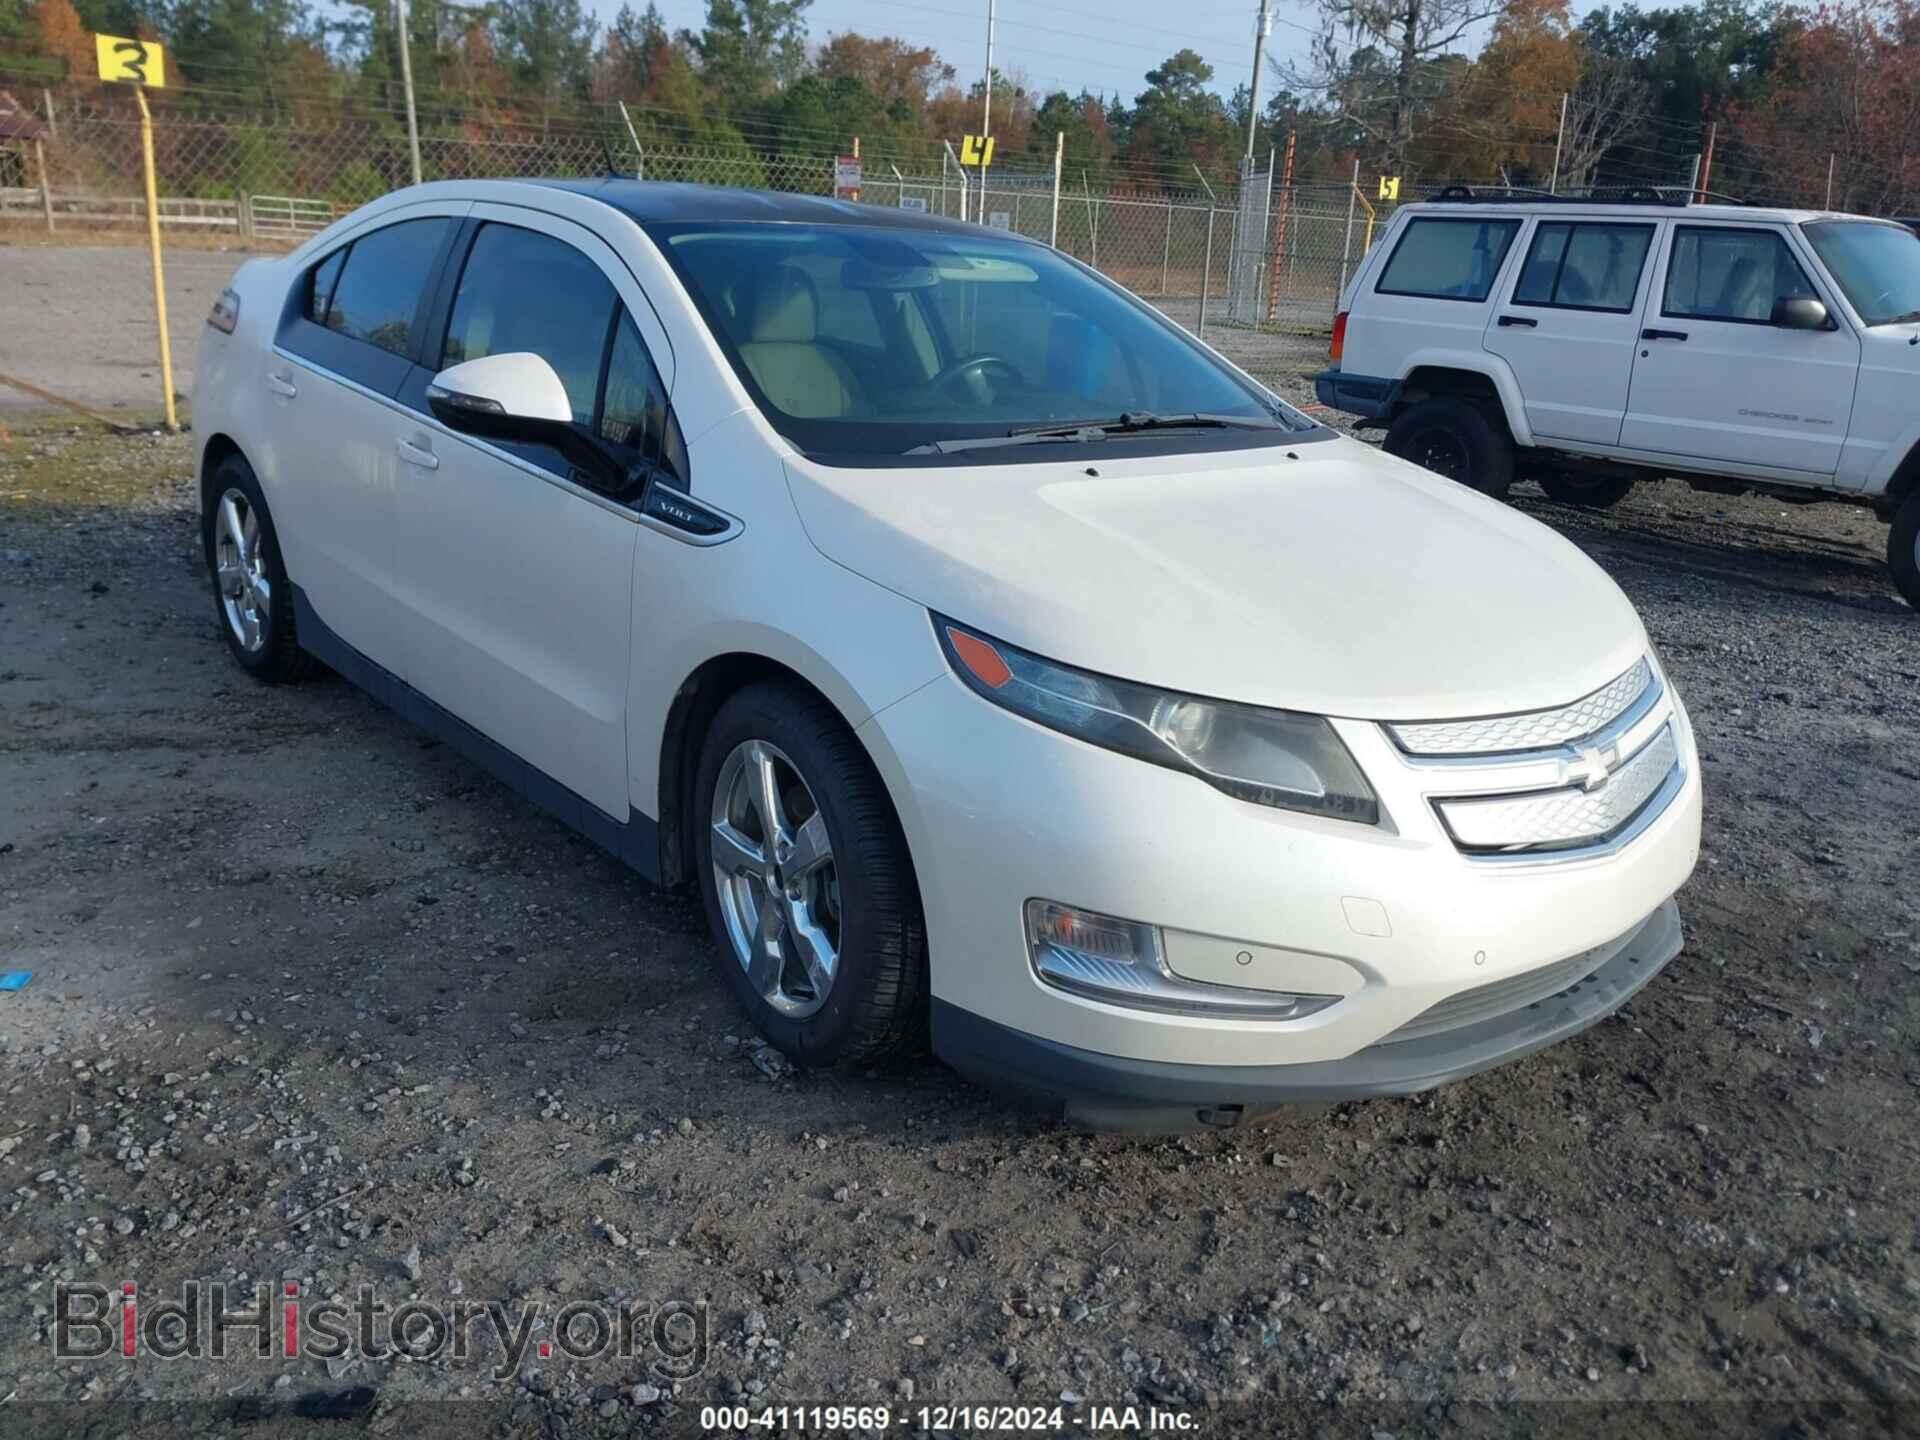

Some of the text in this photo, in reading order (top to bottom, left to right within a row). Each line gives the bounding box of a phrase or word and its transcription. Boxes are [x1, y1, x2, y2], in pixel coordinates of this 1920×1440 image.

[113, 41, 148, 82] 3
[971, 136, 989, 164] 4
[1383, 181, 1394, 198] 5
